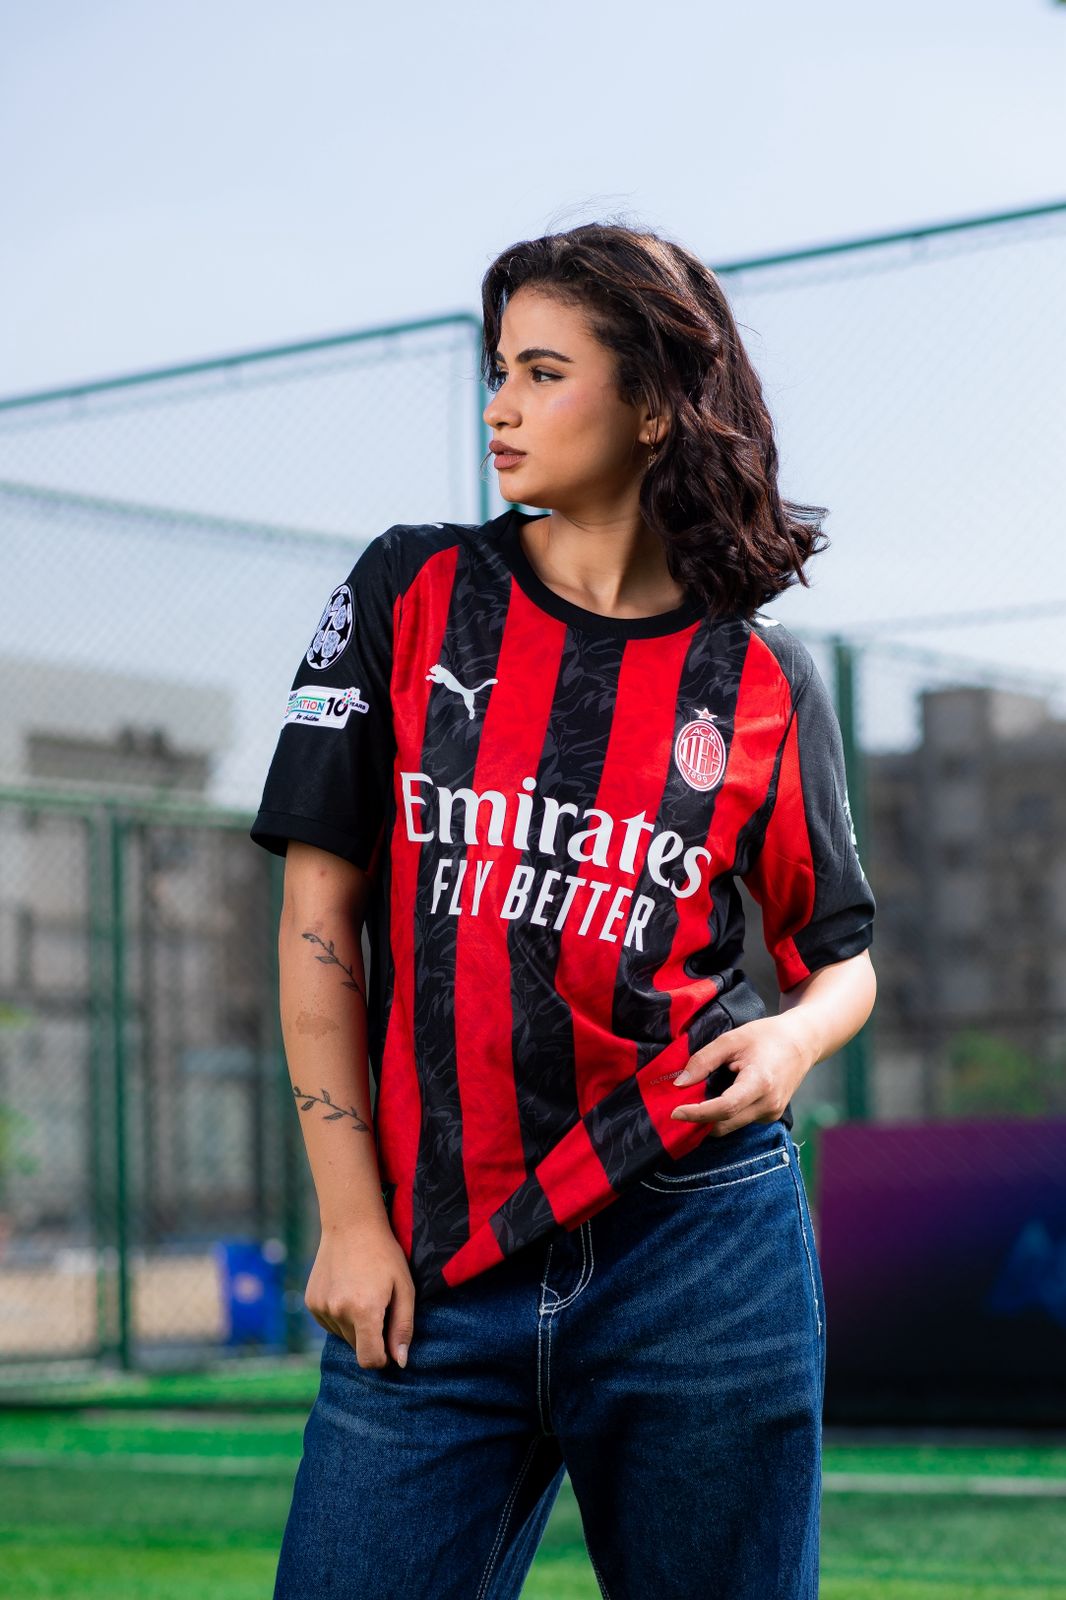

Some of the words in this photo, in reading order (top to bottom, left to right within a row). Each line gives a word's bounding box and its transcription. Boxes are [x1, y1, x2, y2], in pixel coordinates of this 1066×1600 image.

[325, 697, 349, 717] 10
[690, 727, 717, 746] ACM
[687, 769, 708, 784] 1899
[400, 771, 713, 899] Emirates
[430, 858, 495, 917] FLY
[500, 864, 656, 952] BETTER
